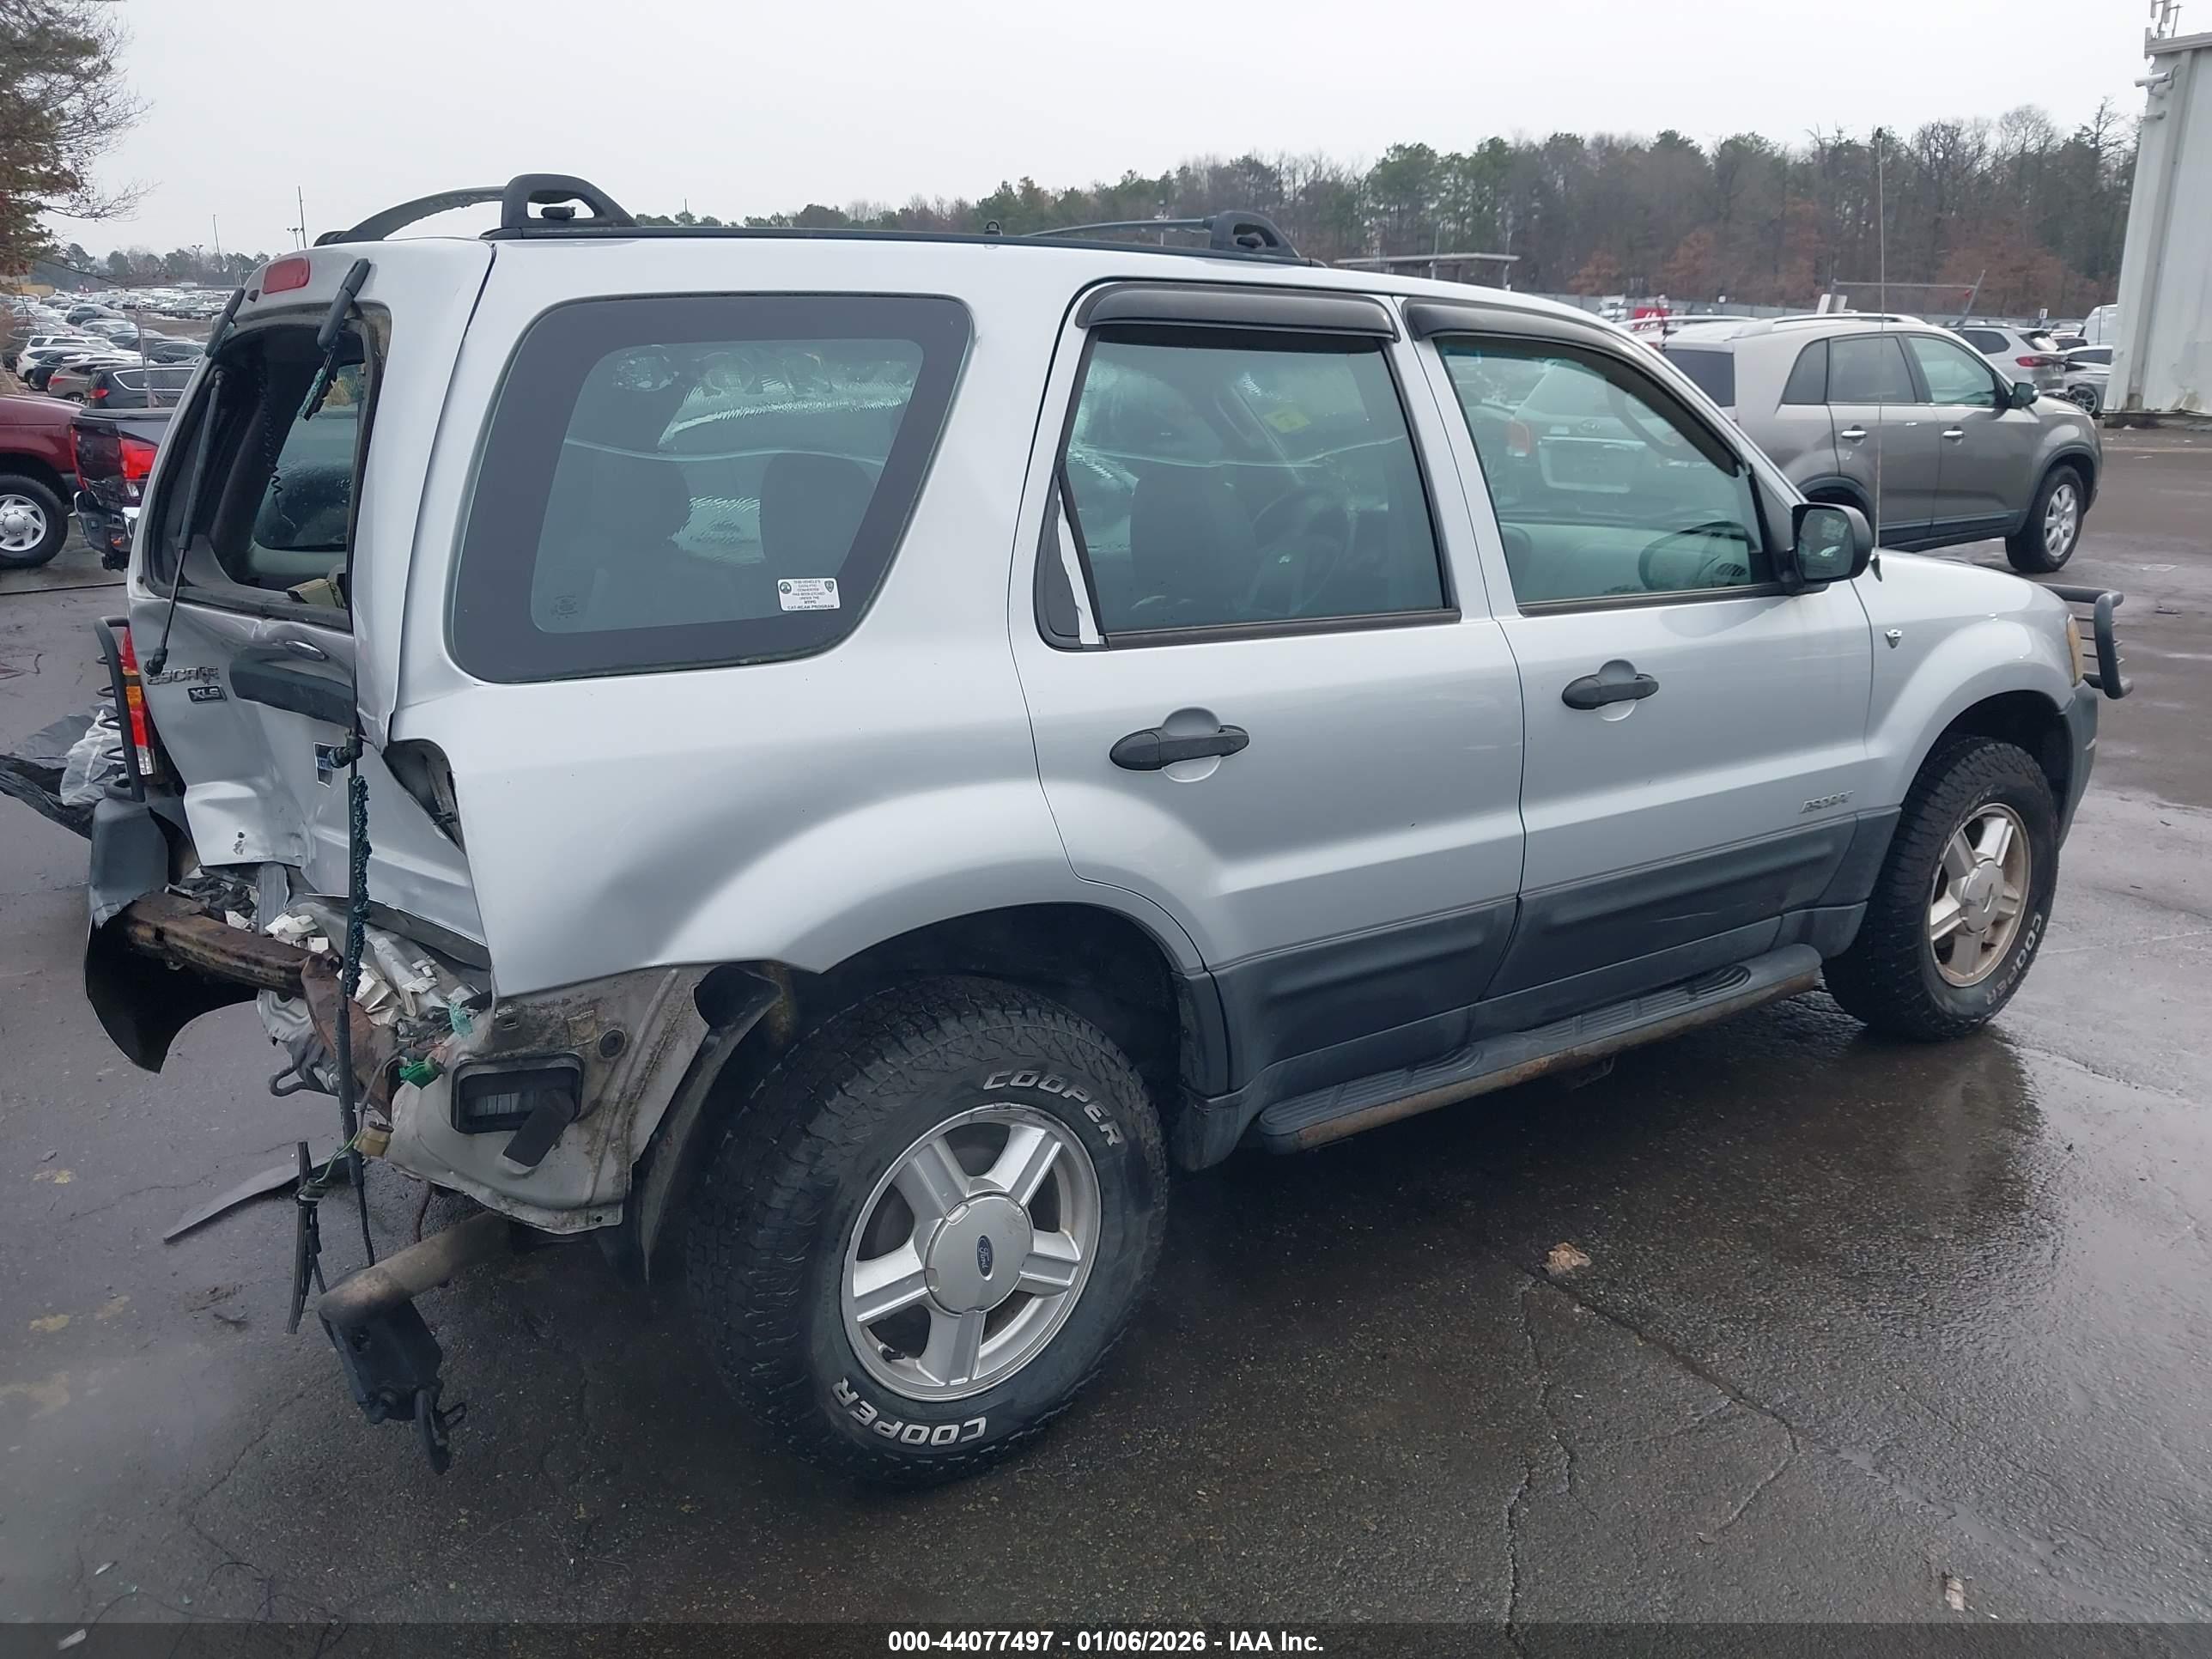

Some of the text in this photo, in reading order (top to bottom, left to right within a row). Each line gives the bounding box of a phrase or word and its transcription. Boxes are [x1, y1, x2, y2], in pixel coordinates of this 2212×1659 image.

[1985, 912, 2042, 1006] COOPER
[983, 1069, 1123, 1146] COOPER
[831, 1376, 987, 1446] COOPER
